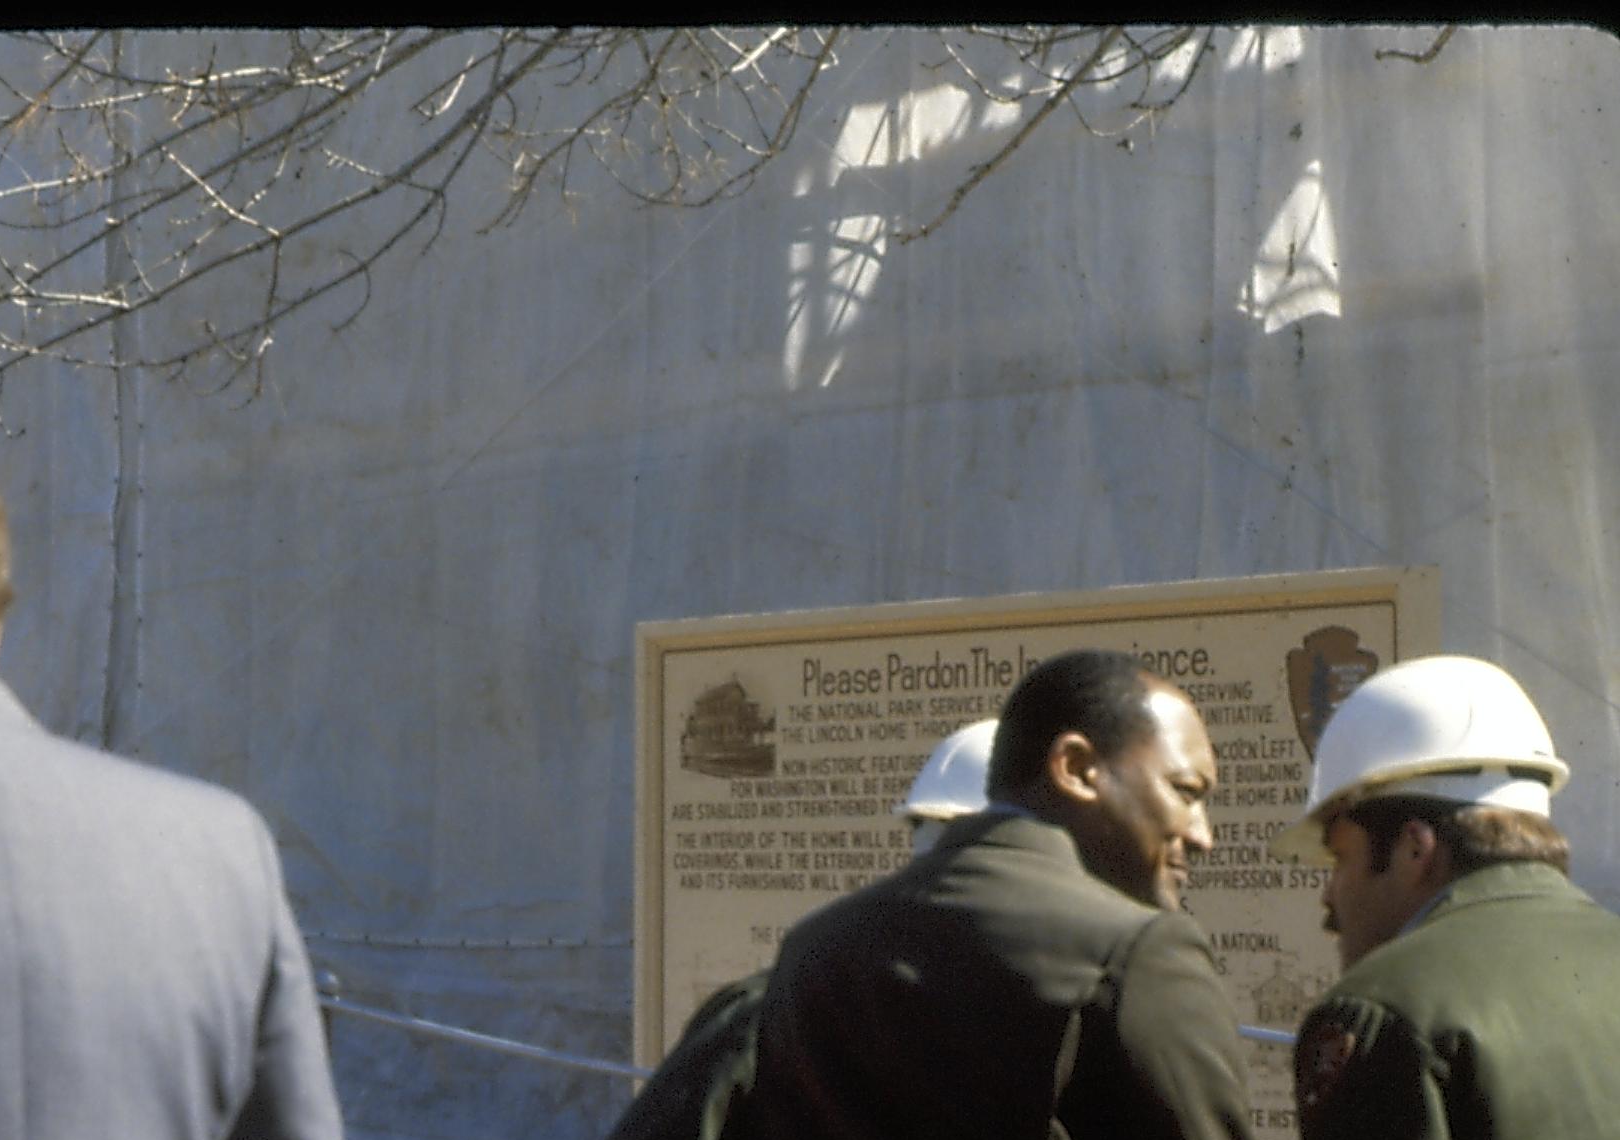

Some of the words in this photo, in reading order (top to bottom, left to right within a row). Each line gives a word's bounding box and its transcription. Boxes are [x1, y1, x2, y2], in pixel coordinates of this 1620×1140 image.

[802, 658, 881, 697] Please
[886, 651, 968, 692] Pardon
[970, 647, 1013, 688] The
[788, 704, 813, 723] THE
[816, 700, 882, 722] NATIONAL
[888, 698, 923, 718] PARK
[929, 696, 984, 716] SERVICE
[1180, 681, 1254, 703] SERVING
[781, 727, 807, 745] THE
[808, 723, 864, 744] LINCOLN
[868, 721, 909, 741] HOME
[1261, 737, 1295, 759] LEFT
[1236, 762, 1303, 783] BUILDING
[1236, 786, 1278, 807] HOME
[677, 832, 697, 849] THE
[699, 832, 755, 850] INTERIOR
[758, 831, 776, 849] OF
[781, 830, 808, 849] THE
[811, 830, 847, 849] HOME
[851, 830, 882, 848] WILL
[787, 851, 809, 869] THE
[1187, 869, 1283, 890] SUPPRESSION
[1220, 931, 1283, 953] NATIONAL
